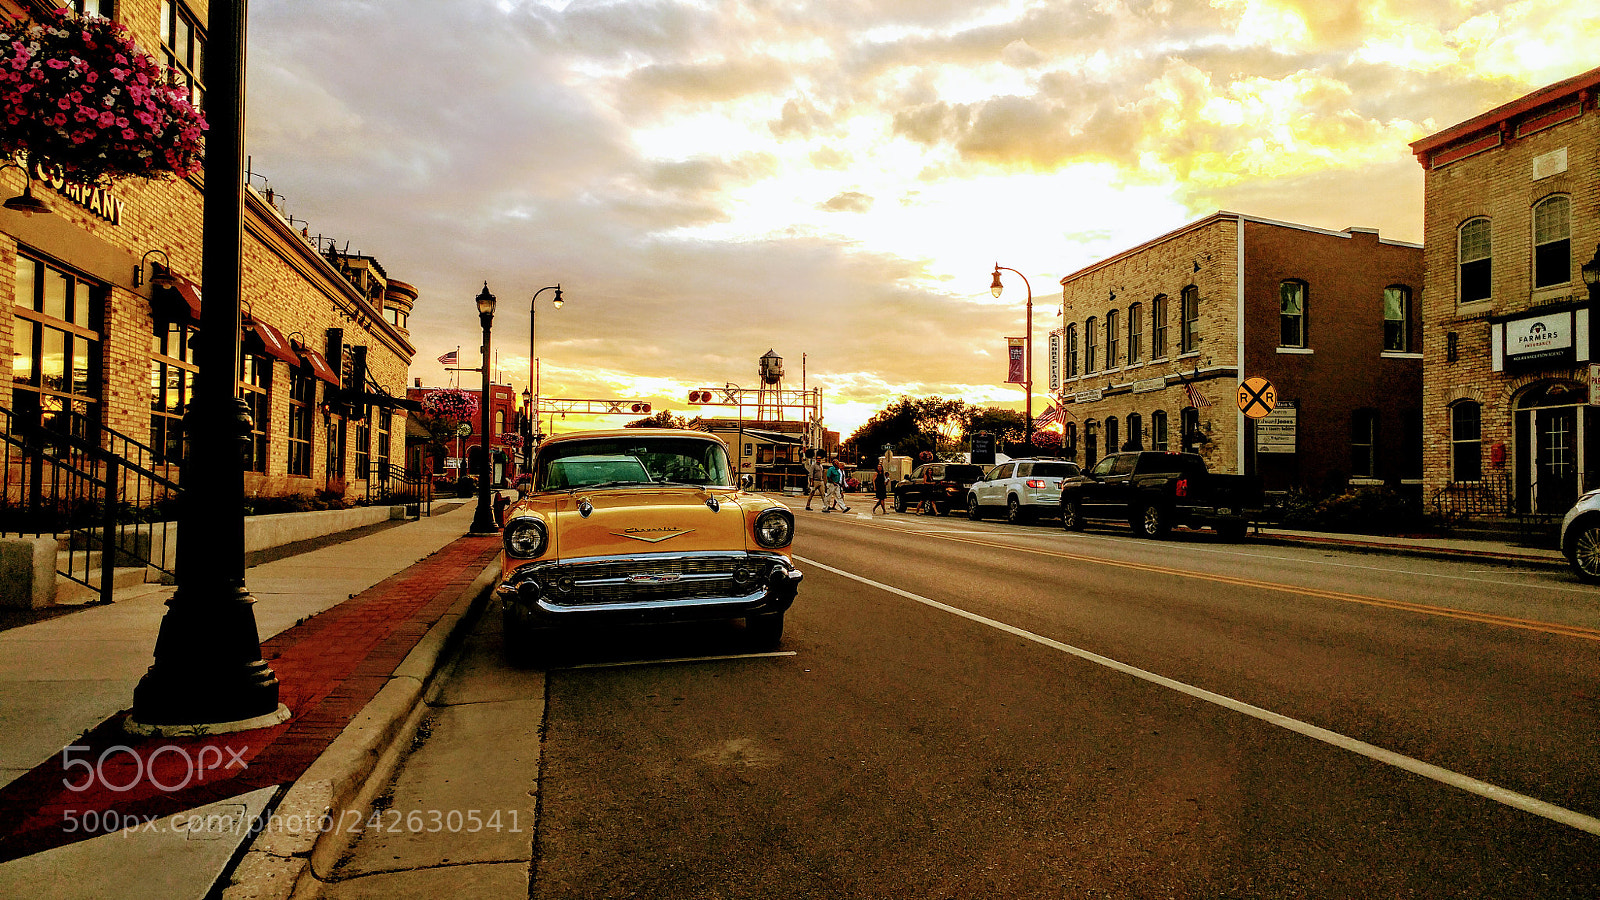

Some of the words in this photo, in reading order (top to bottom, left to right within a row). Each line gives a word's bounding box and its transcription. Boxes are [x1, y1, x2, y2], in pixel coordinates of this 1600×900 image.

[1519, 332, 1558, 343] FARMERS
[1240, 392, 1248, 403] R
[1266, 392, 1274, 403] R
